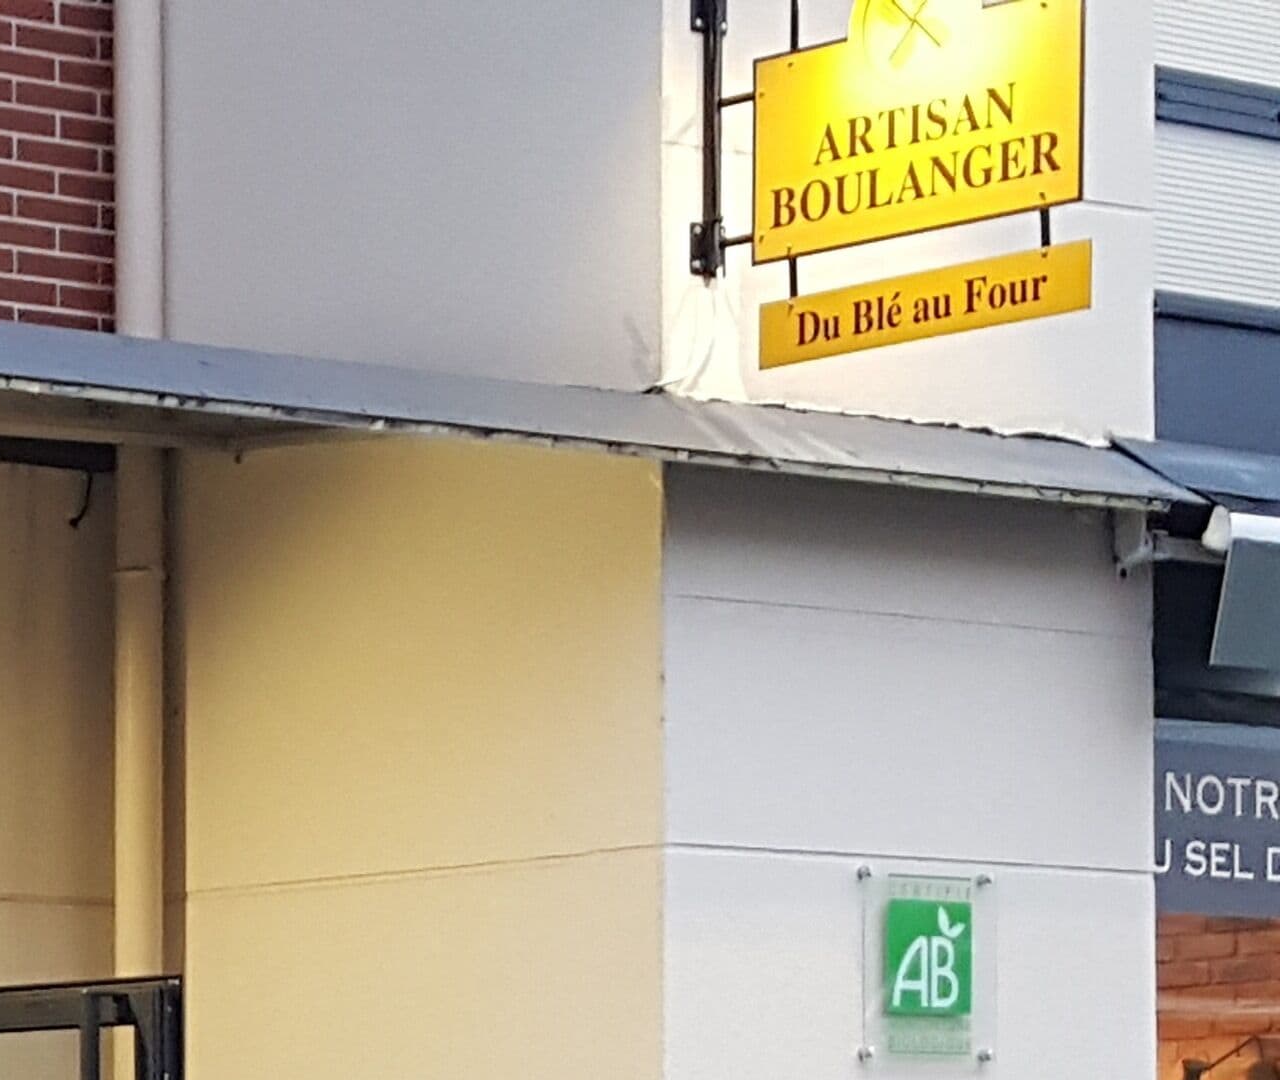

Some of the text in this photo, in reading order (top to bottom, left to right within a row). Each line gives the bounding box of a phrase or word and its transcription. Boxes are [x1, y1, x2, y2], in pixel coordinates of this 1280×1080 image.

[813, 81, 1017, 165] ARTISAN
[769, 131, 1061, 230] BOULANGER
[796, 271, 1049, 347] Du Blé au Four
[1165, 772, 1280, 820] NOTR
[1184, 840, 1255, 880] SEL
[892, 935, 959, 1008] AB
